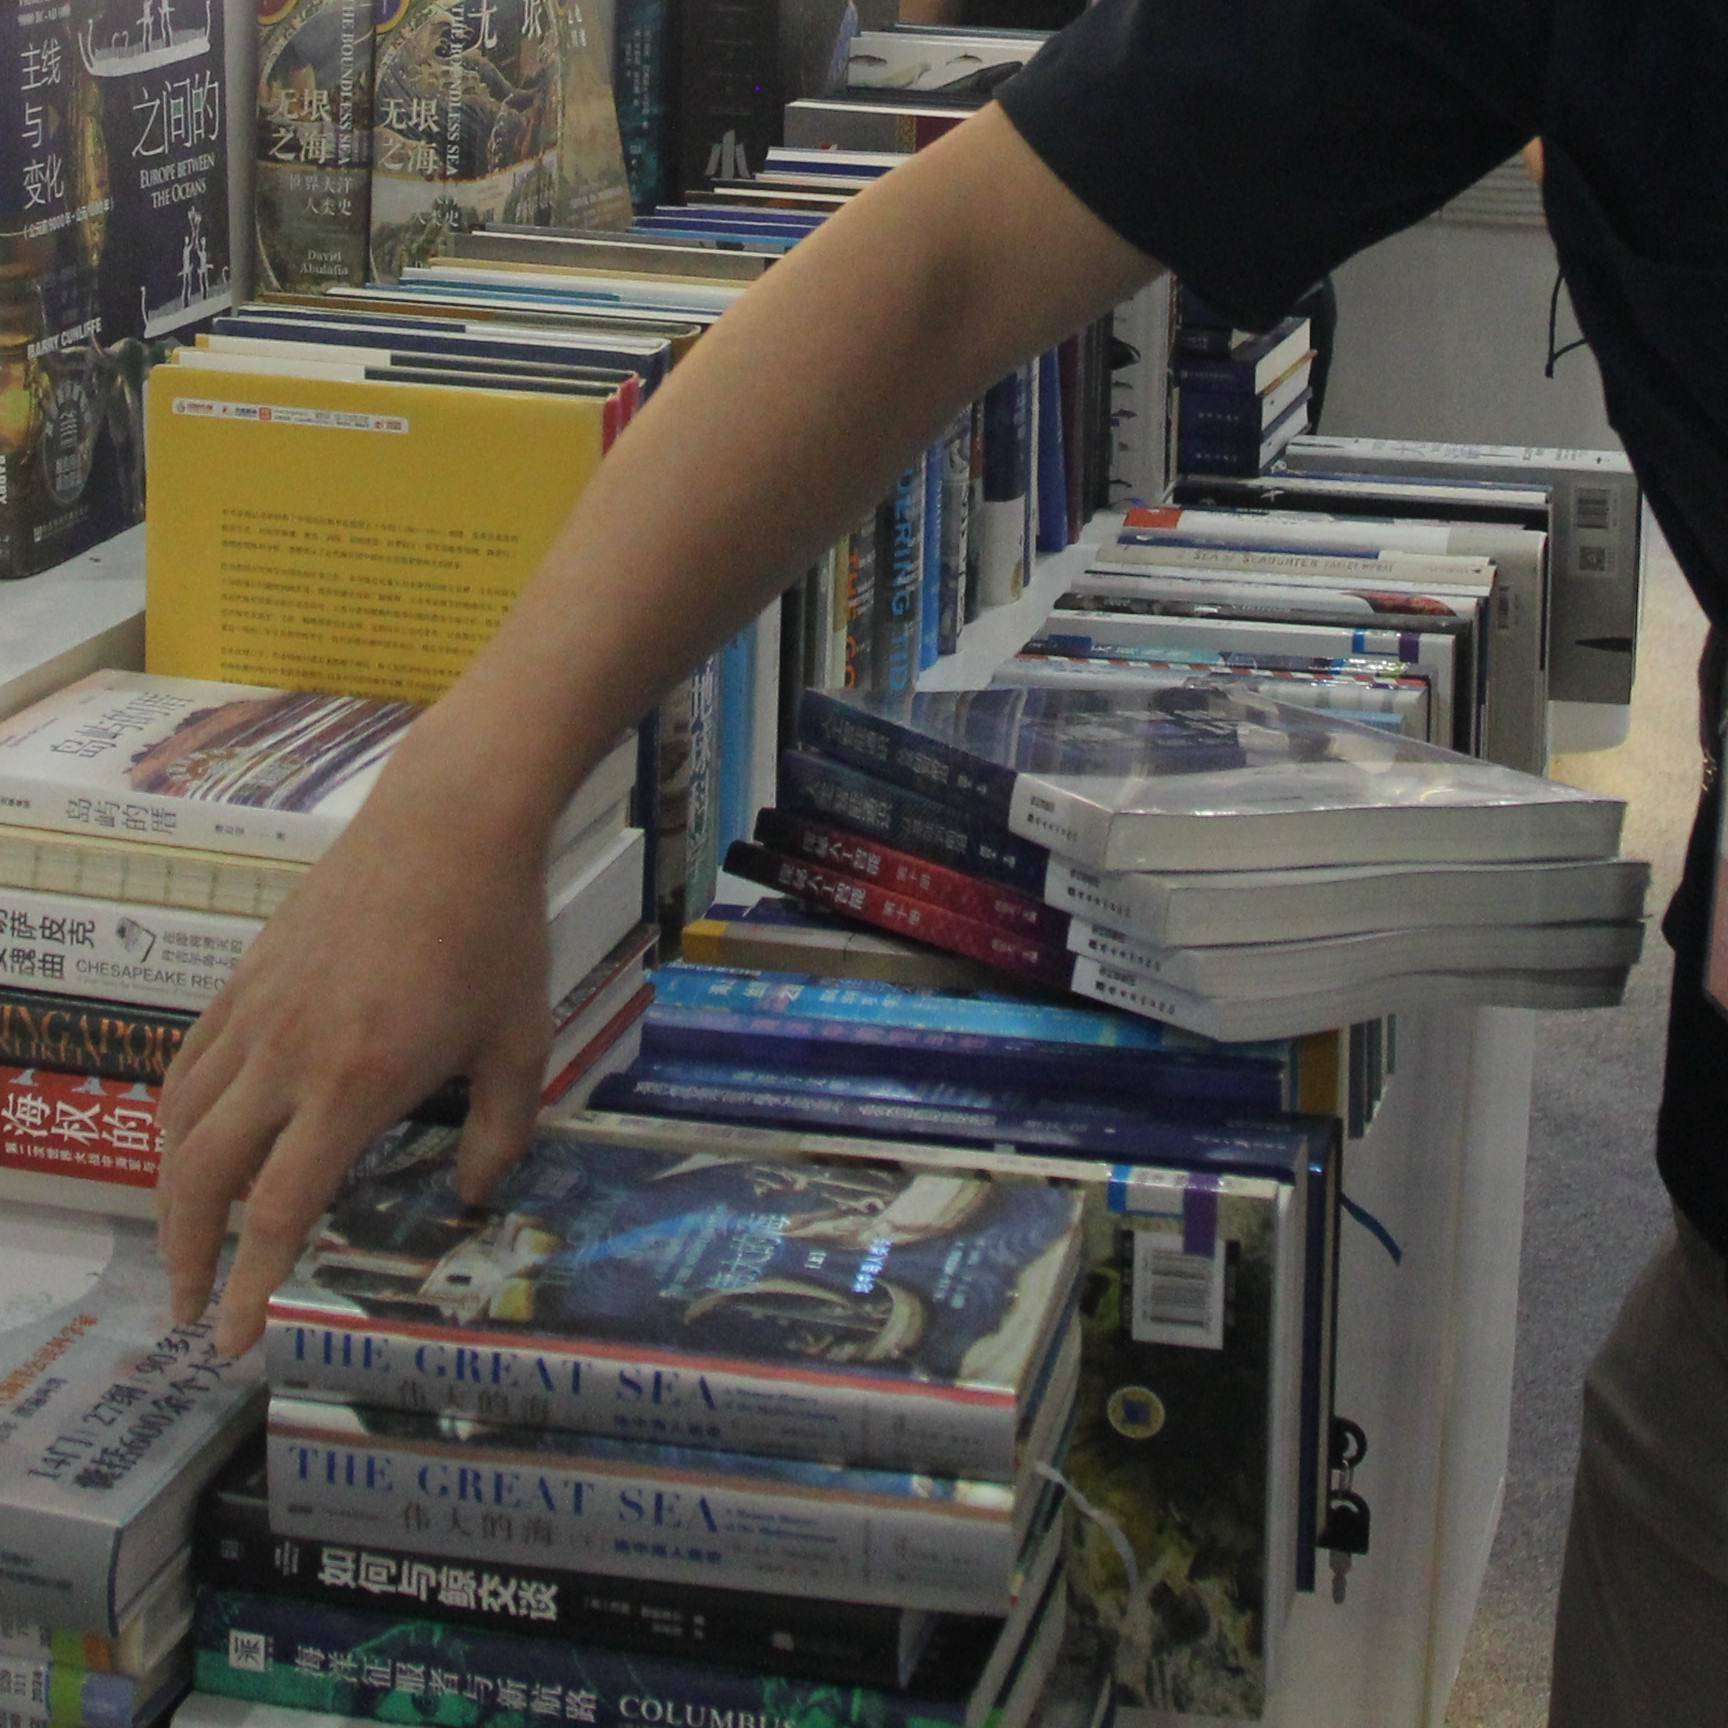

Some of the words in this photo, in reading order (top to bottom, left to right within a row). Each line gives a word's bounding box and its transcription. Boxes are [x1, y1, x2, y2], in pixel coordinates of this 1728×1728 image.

[21, 38, 62, 91] 主线
[340, 28, 355, 119] BOUNDLESS
[131, 69, 221, 158] 之间的
[271, 88, 331, 123] 无垠
[380, 95, 441, 134] 无垠
[269, 129, 331, 165] 之海
[338, 123, 352, 165] SEA
[378, 136, 440, 175] 之海
[23, 152, 65, 210] 变化
[151, 188, 171, 209] THE
[172, 177, 209, 203] OCEANS
[27, 336, 61, 361] BARRY
[60, 317, 102, 347] CUNLIFFE
[1242, 553, 1319, 569] SLAUGHTER
[75, 958, 189, 989] CHESAPEAKE
[1, 1093, 165, 1154] 海权的
[286, 1327, 391, 1372] THE
[414, 1343, 593, 1397] GREAT
[616, 1367, 718, 1412] SEA
[398, 1378, 551, 1421] 伟大的海
[288, 1446, 394, 1490] THE
[417, 1464, 595, 1518] GREAT
[618, 1486, 719, 1533] SEA
[401, 1499, 555, 1544] 伟大的海
[317, 1544, 560, 1623] 如何与鲸交谈
[293, 1641, 599, 1725] 海洋征服者与新航路
